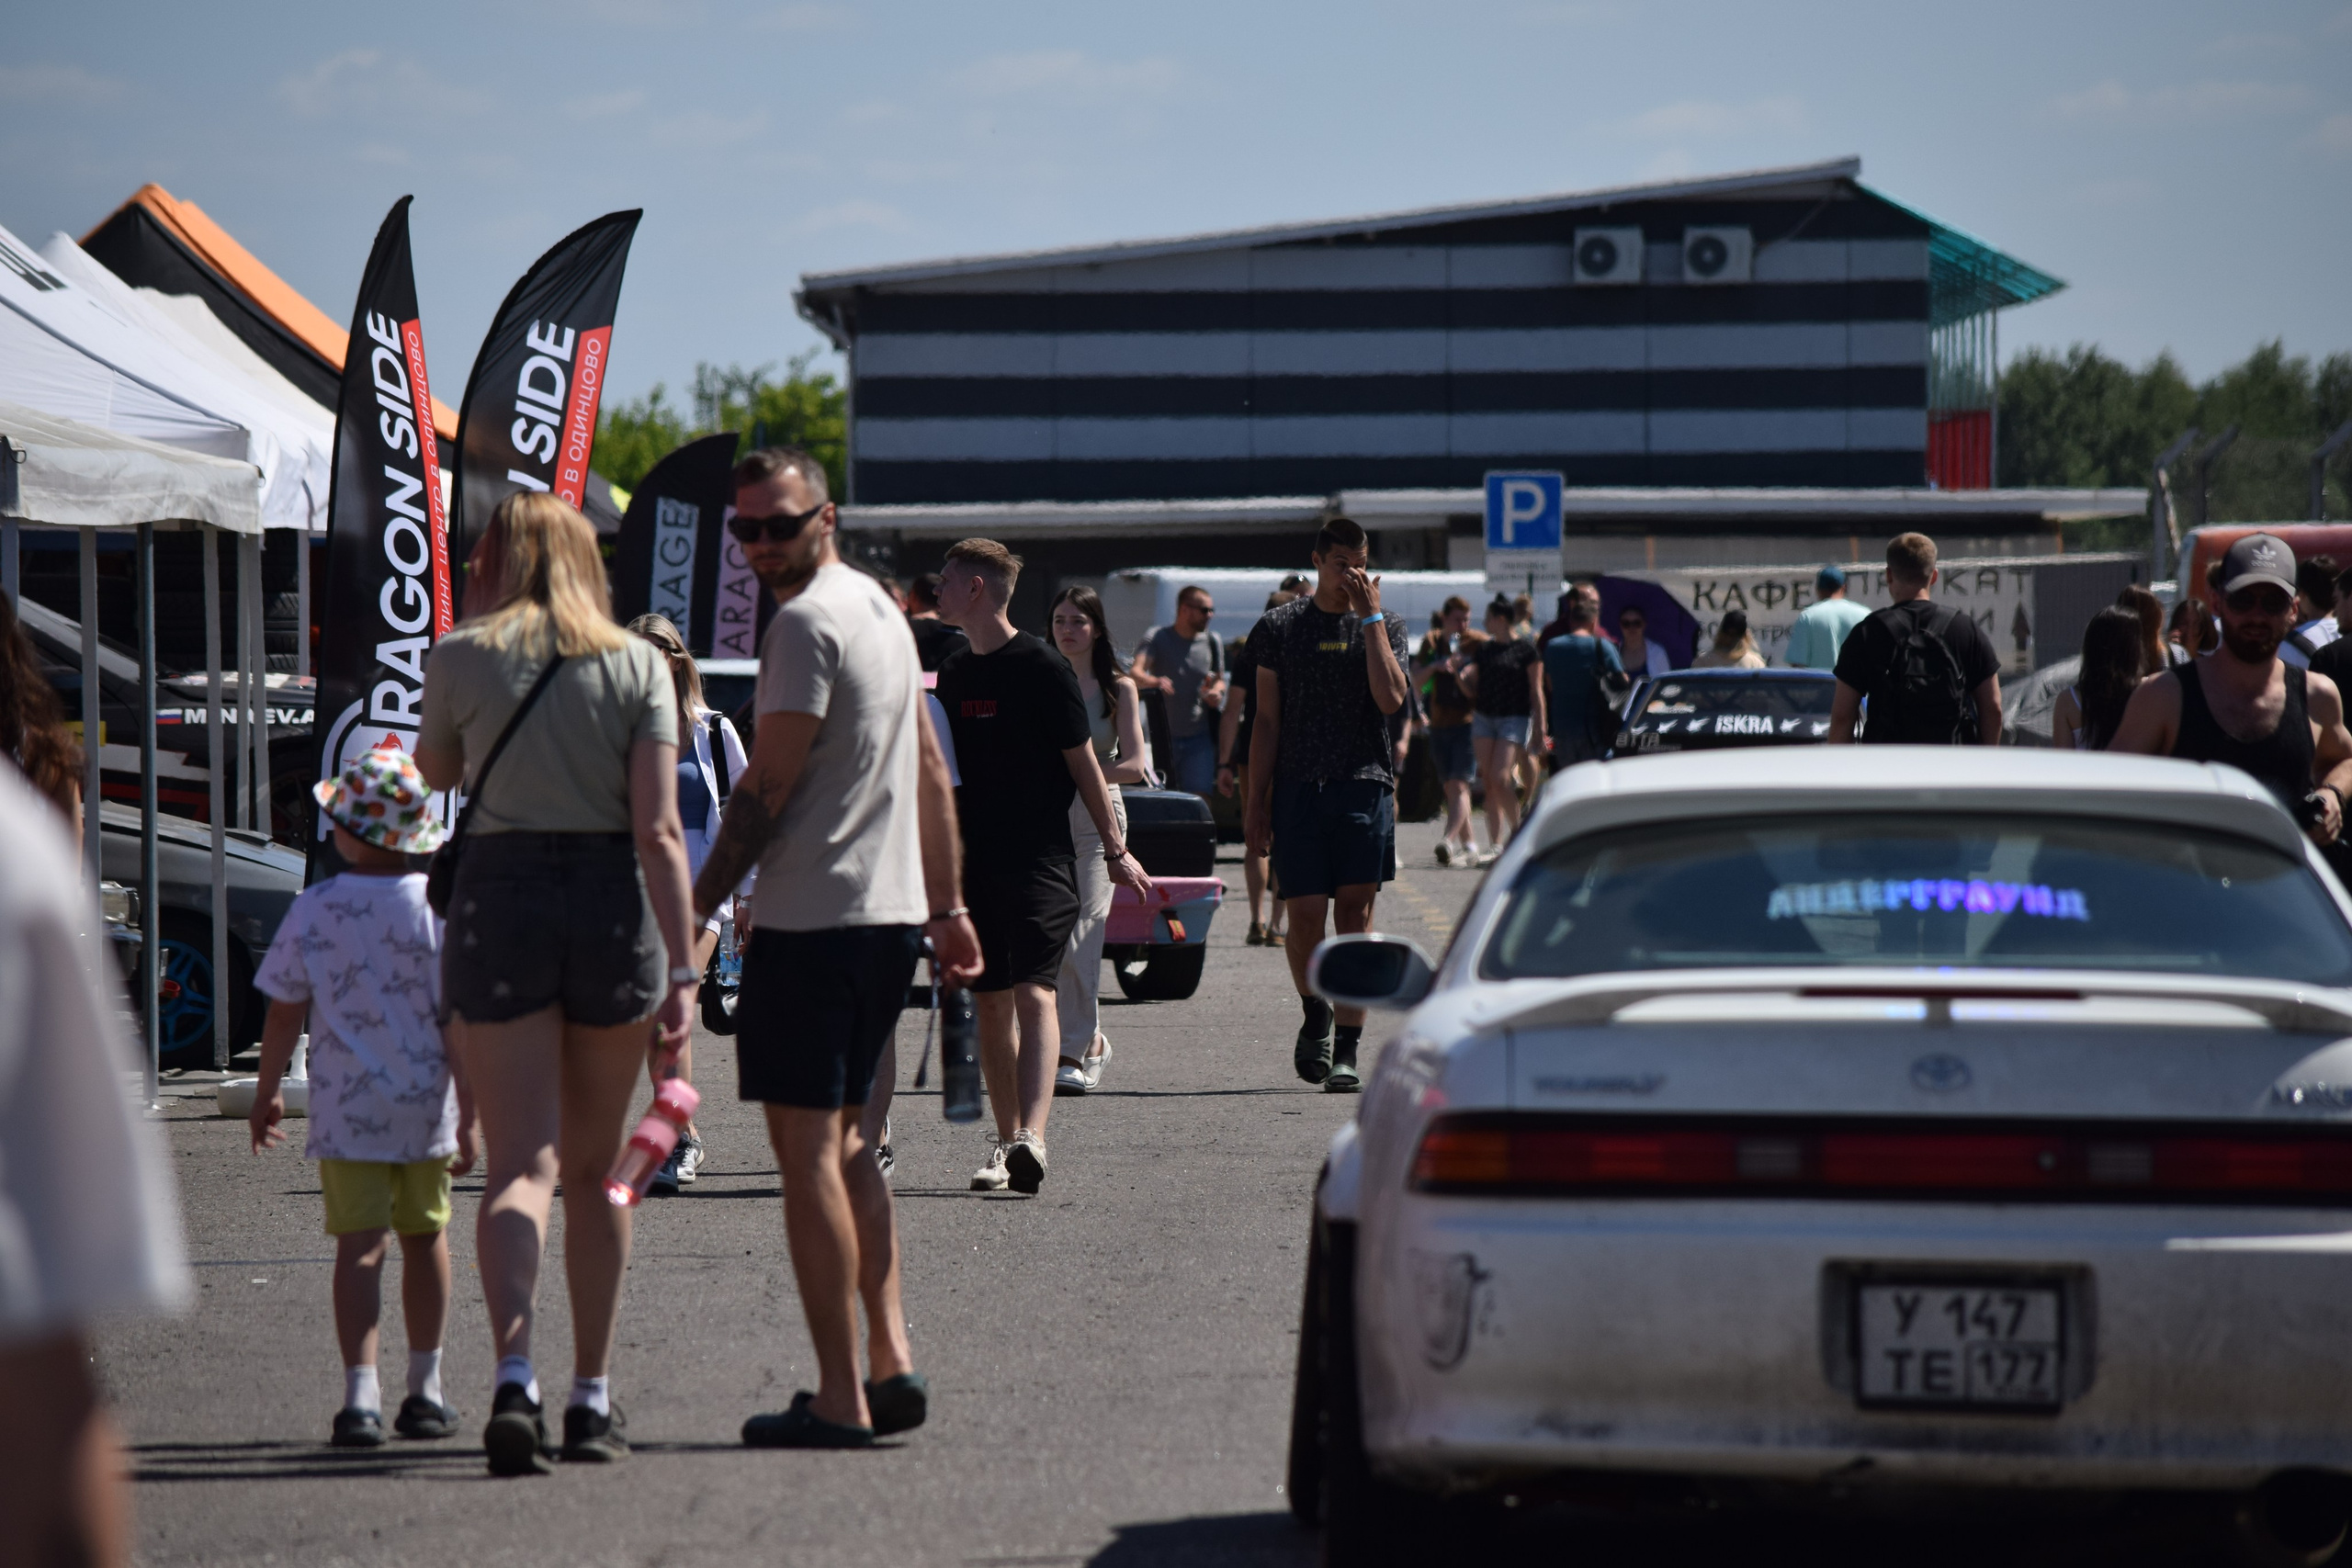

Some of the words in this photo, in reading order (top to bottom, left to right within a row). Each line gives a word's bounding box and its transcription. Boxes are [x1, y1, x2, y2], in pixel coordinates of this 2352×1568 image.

[366, 307, 419, 460] SIDE
[408, 331, 437, 457] ОДИНЦОВО
[511, 318, 576, 465] SIDE
[569, 337, 602, 462] ОДИНЦОВО
[564, 468, 580, 483] В
[1501, 479, 1547, 544] P
[658, 507, 694, 639] RAGE
[1692, 579, 1815, 611] КАФЕ
[1941, 1292, 2029, 1338] 147
[1884, 1348, 1954, 1393] ТЕ
[1977, 1349, 2048, 1384] 177
